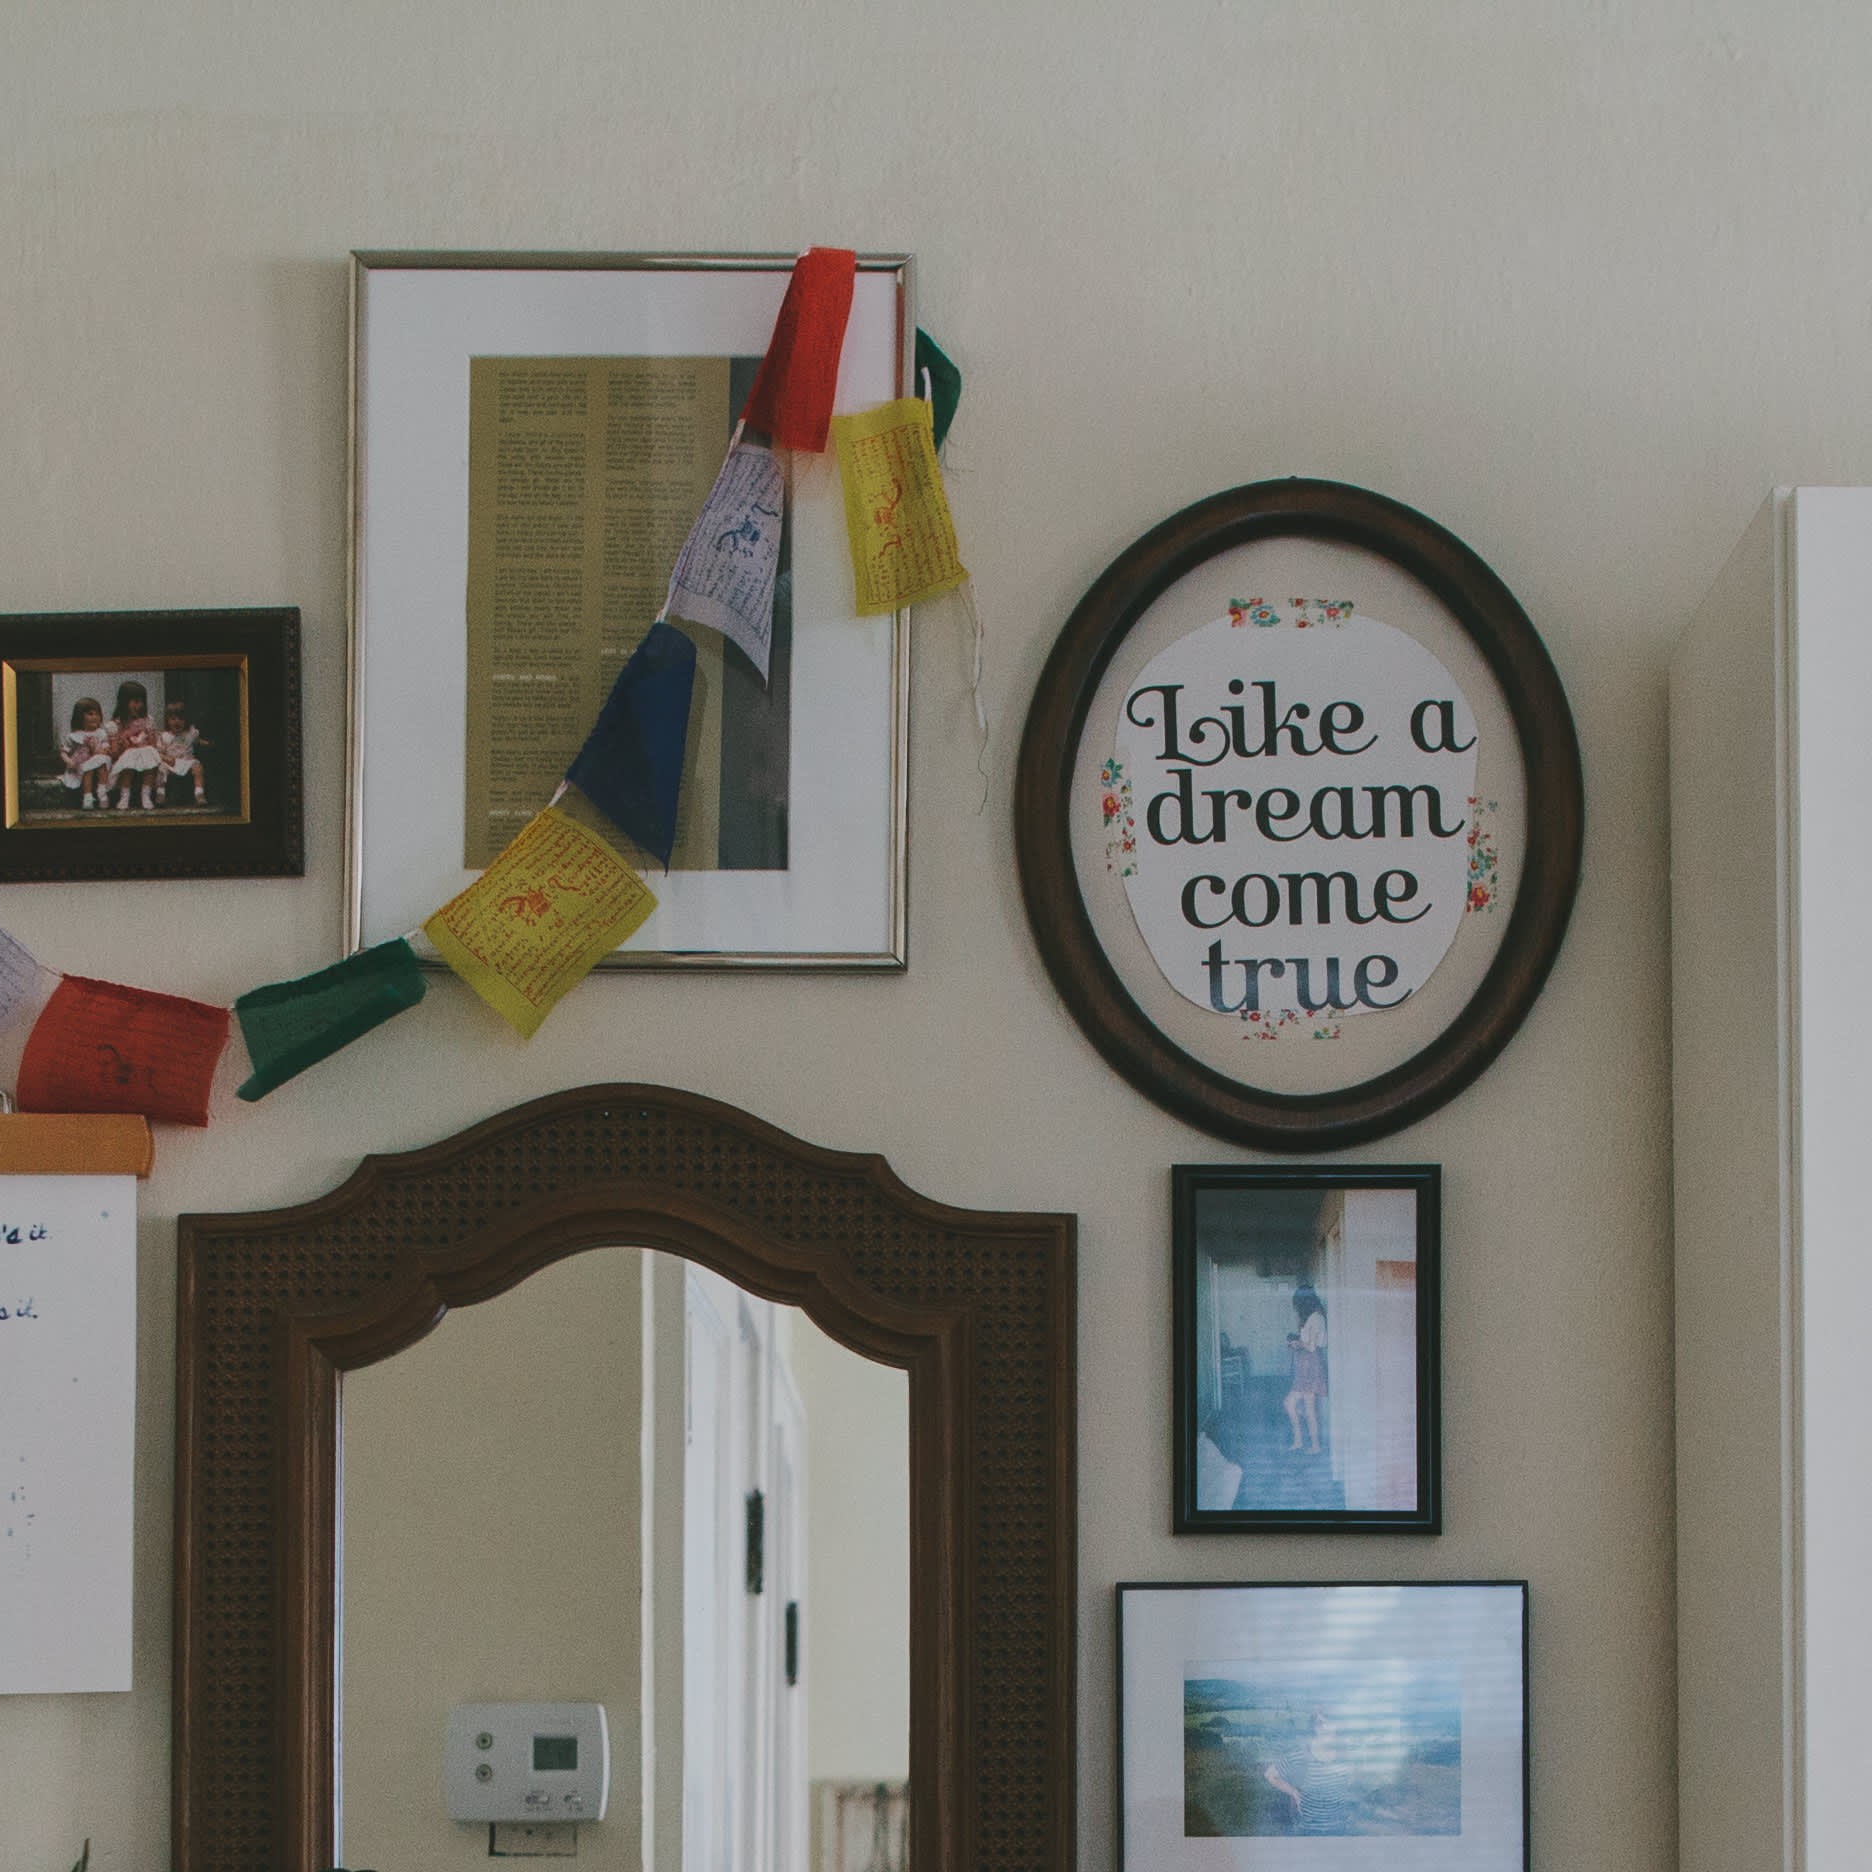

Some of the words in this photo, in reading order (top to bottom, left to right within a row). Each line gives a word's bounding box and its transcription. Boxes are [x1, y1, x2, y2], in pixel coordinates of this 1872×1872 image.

[1126, 679, 1378, 767] Like
[1409, 697, 1478, 755] a
[1145, 768, 1466, 846] dream
[1180, 867, 1433, 929] come
[1200, 938, 1414, 1014] true
